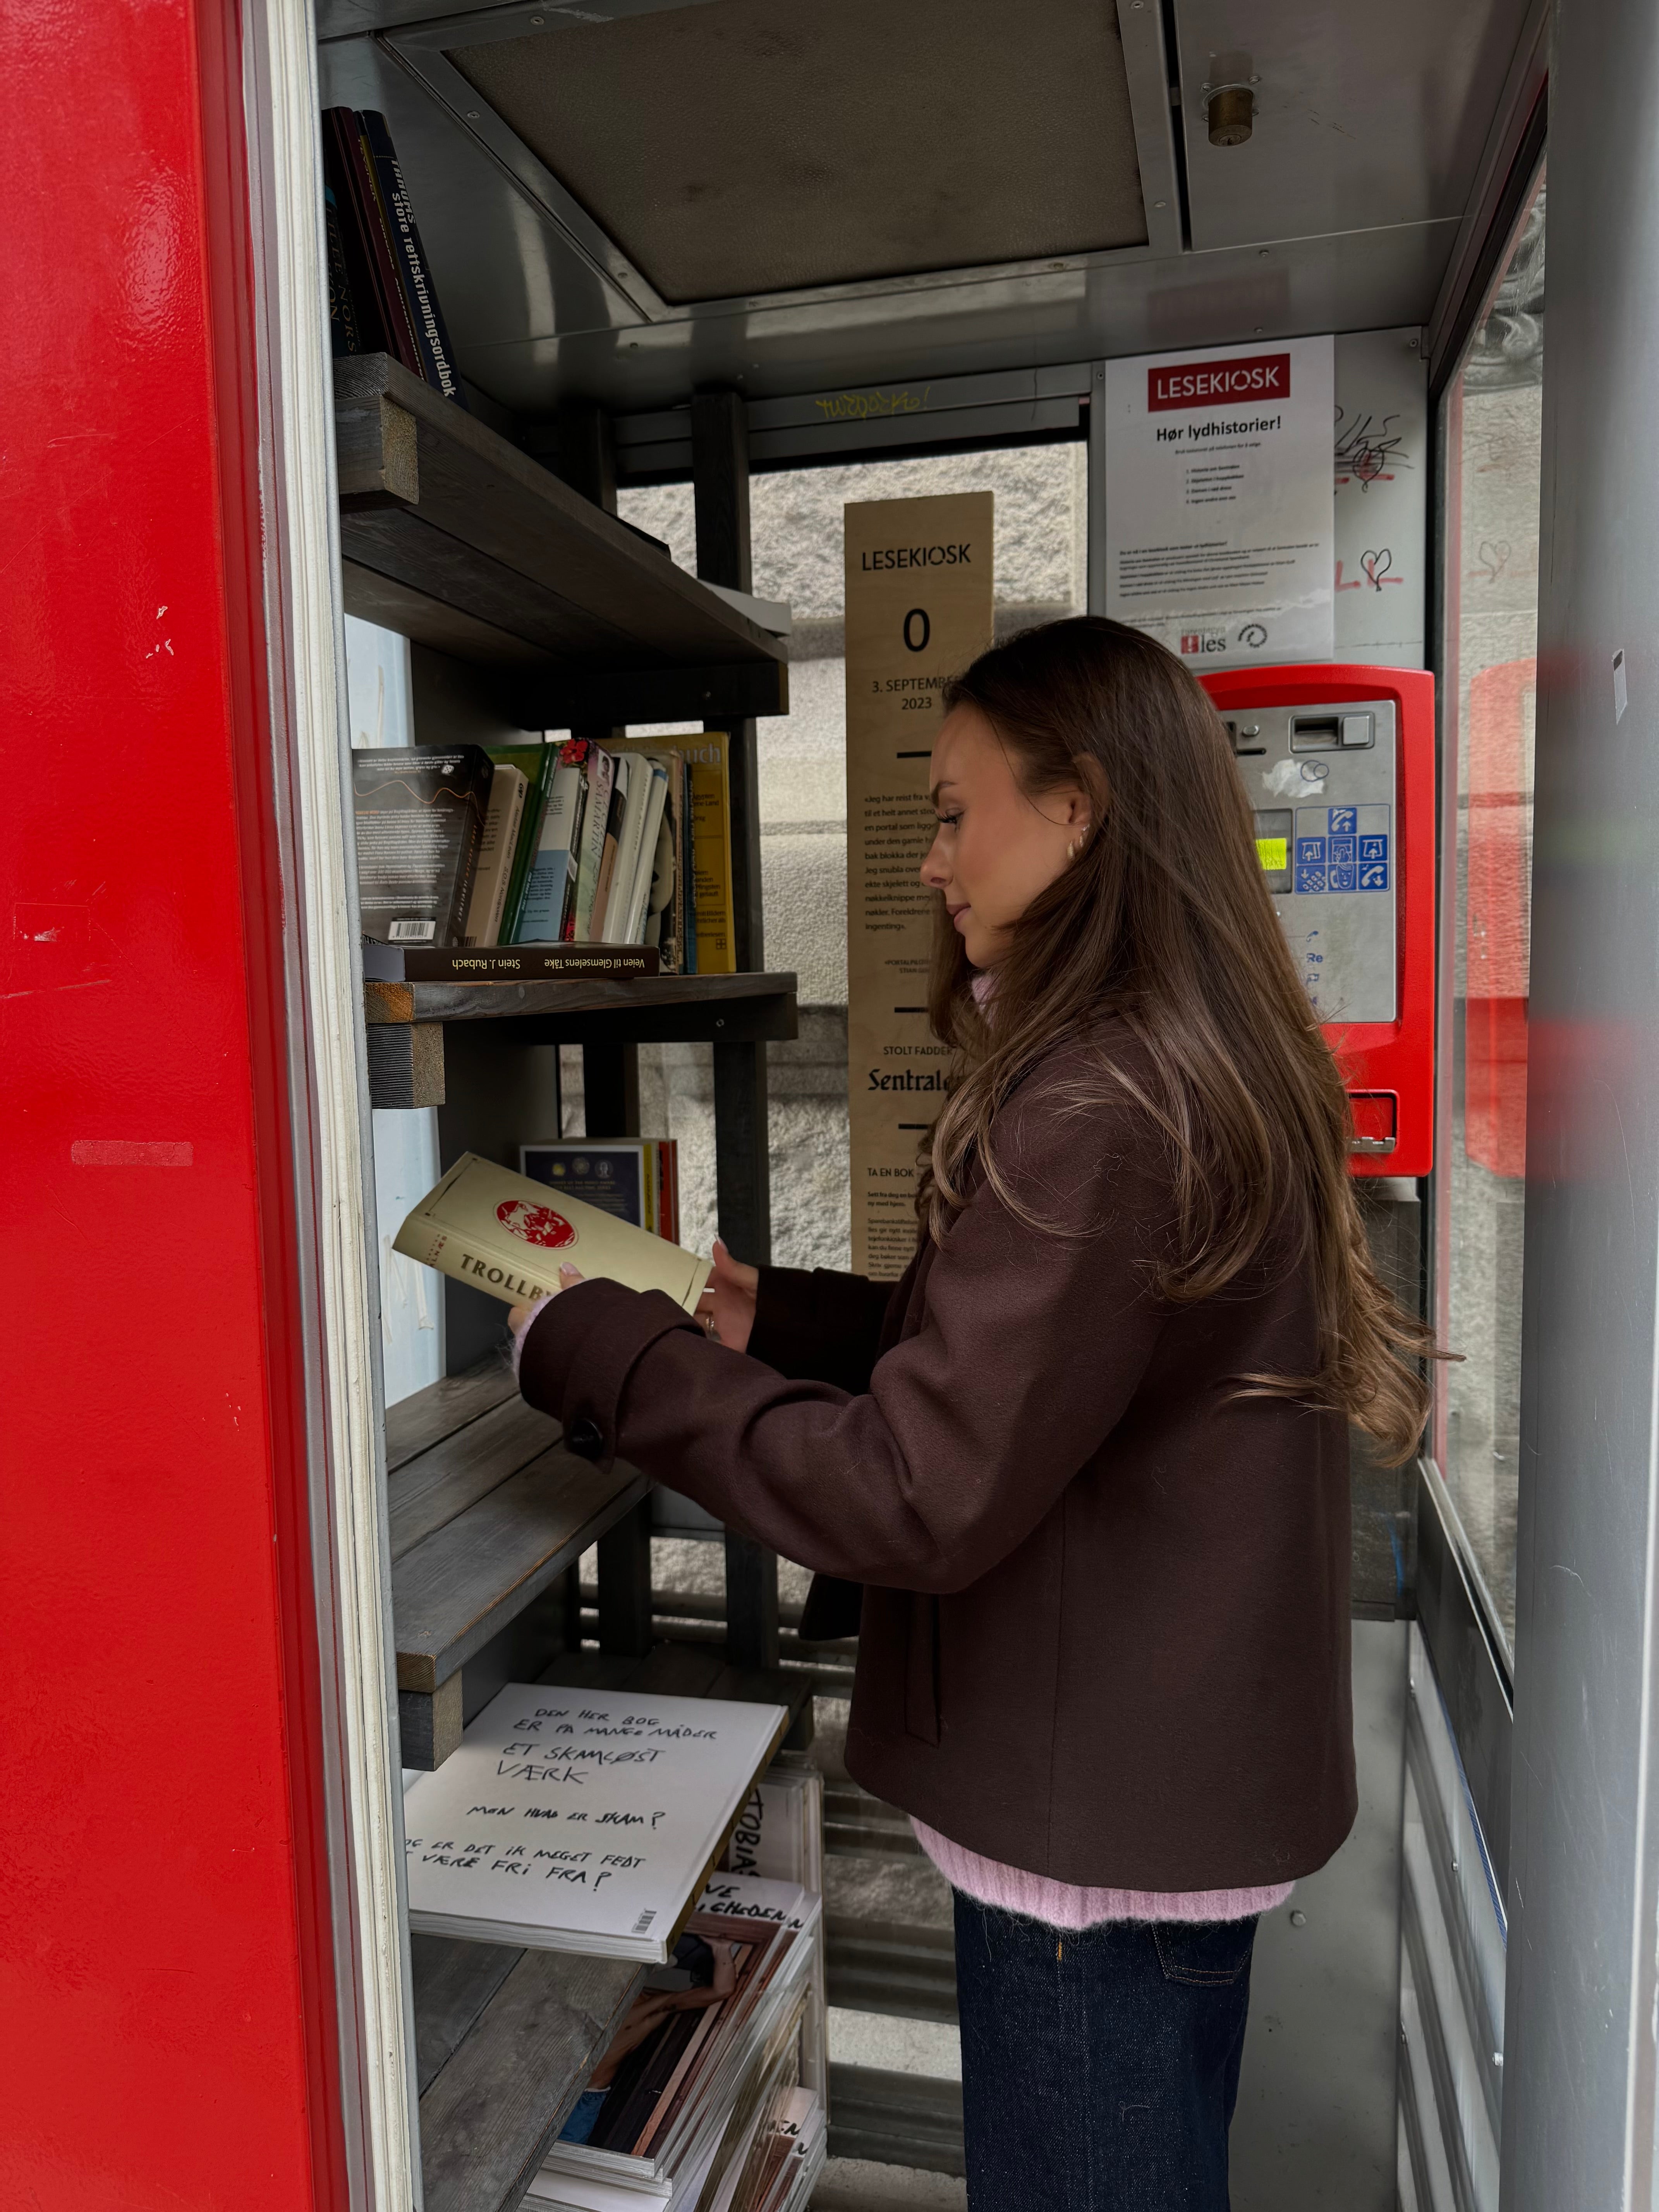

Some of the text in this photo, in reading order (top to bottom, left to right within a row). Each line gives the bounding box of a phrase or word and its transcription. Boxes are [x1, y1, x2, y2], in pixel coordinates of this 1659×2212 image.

[390, 158, 416, 225] TANUMS
[391, 192, 457, 397] store rettskrivningsordbok
[1157, 366, 1280, 400] LESEKIOSK
[1157, 416, 1281, 442] Hør lydhistorier!
[862, 543, 971, 571] LESEKIOSK
[903, 608, 930, 652] 0
[872, 681, 883, 693] 3.
[901, 697, 933, 710] 2023
[590, 780, 605, 853] SAMARTIN
[876, 822, 898, 832] portal
[865, 837, 885, 846] under
[865, 866, 878, 875] Jeg
[879, 865, 904, 874] snubla
[882, 879, 909, 889] skjelett
[452, 959, 520, 970] Stein J. Rubach
[544, 958, 564, 969] Tåke
[565, 958, 612, 969] Glemselens
[623, 958, 645, 968] Veien
[883, 1046, 913, 1056] STOLT
[867, 1168, 914, 1178] TA EN BOK
[534, 1709, 661, 1726] DEN HER BOG
[513, 1719, 543, 1731] ER
[648, 1724, 718, 1740] MÅDER
[503, 1742, 666, 1765] ET SKAMLØST
[496, 1760, 589, 1784] VÆRK
[466, 1806, 515, 1815] MON
[567, 1812, 588, 1821] ER
[431, 1841, 455, 1851] ER
[464, 1843, 496, 1854] DET
[533, 1849, 593, 1864] MEGET
[600, 1855, 647, 1869] FEDT
[422, 1854, 481, 1868] VÆRE
[545, 1867, 588, 1883] FRA
